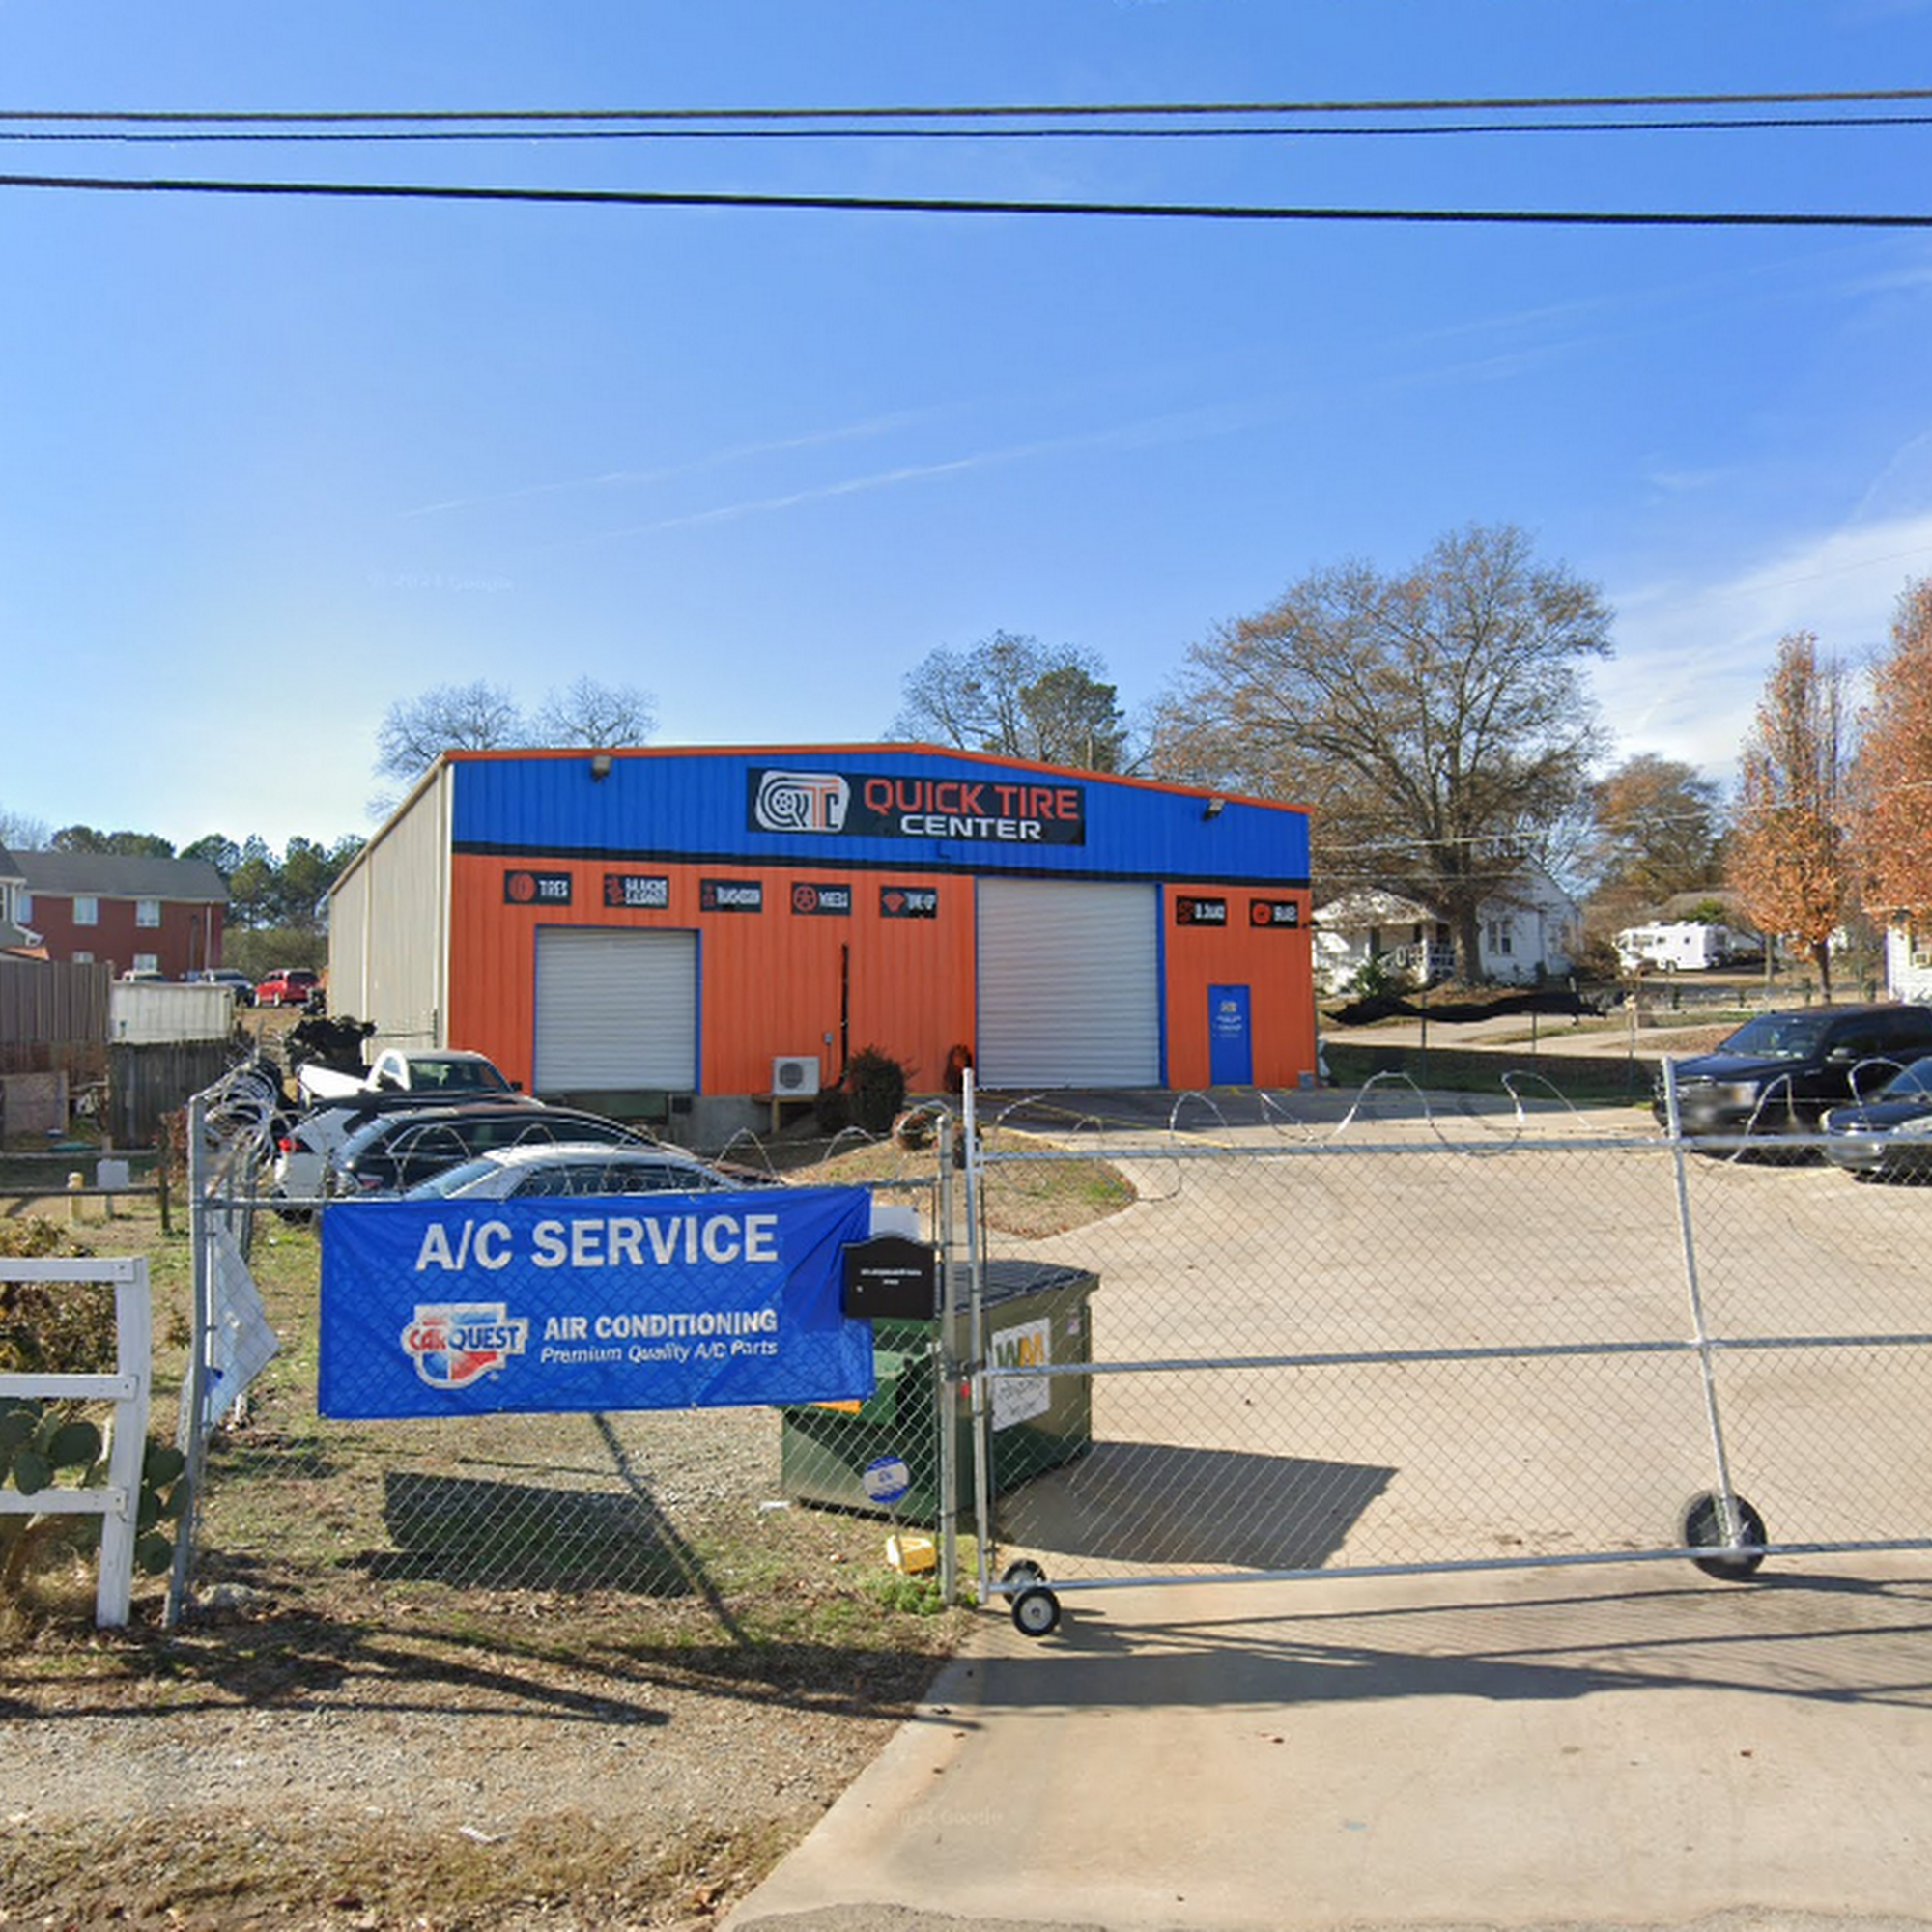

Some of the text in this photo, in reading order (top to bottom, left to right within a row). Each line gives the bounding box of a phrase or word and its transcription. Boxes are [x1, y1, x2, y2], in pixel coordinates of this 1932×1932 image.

[864, 778, 1079, 820] QUICK TIRE
[900, 814, 1042, 840] CENTER
[415, 1214, 778, 1271] A/C SERVICE
[543, 1308, 778, 1341] AIR CONDITIONING
[540, 1339, 778, 1364] Premium Quality A/C Parts
